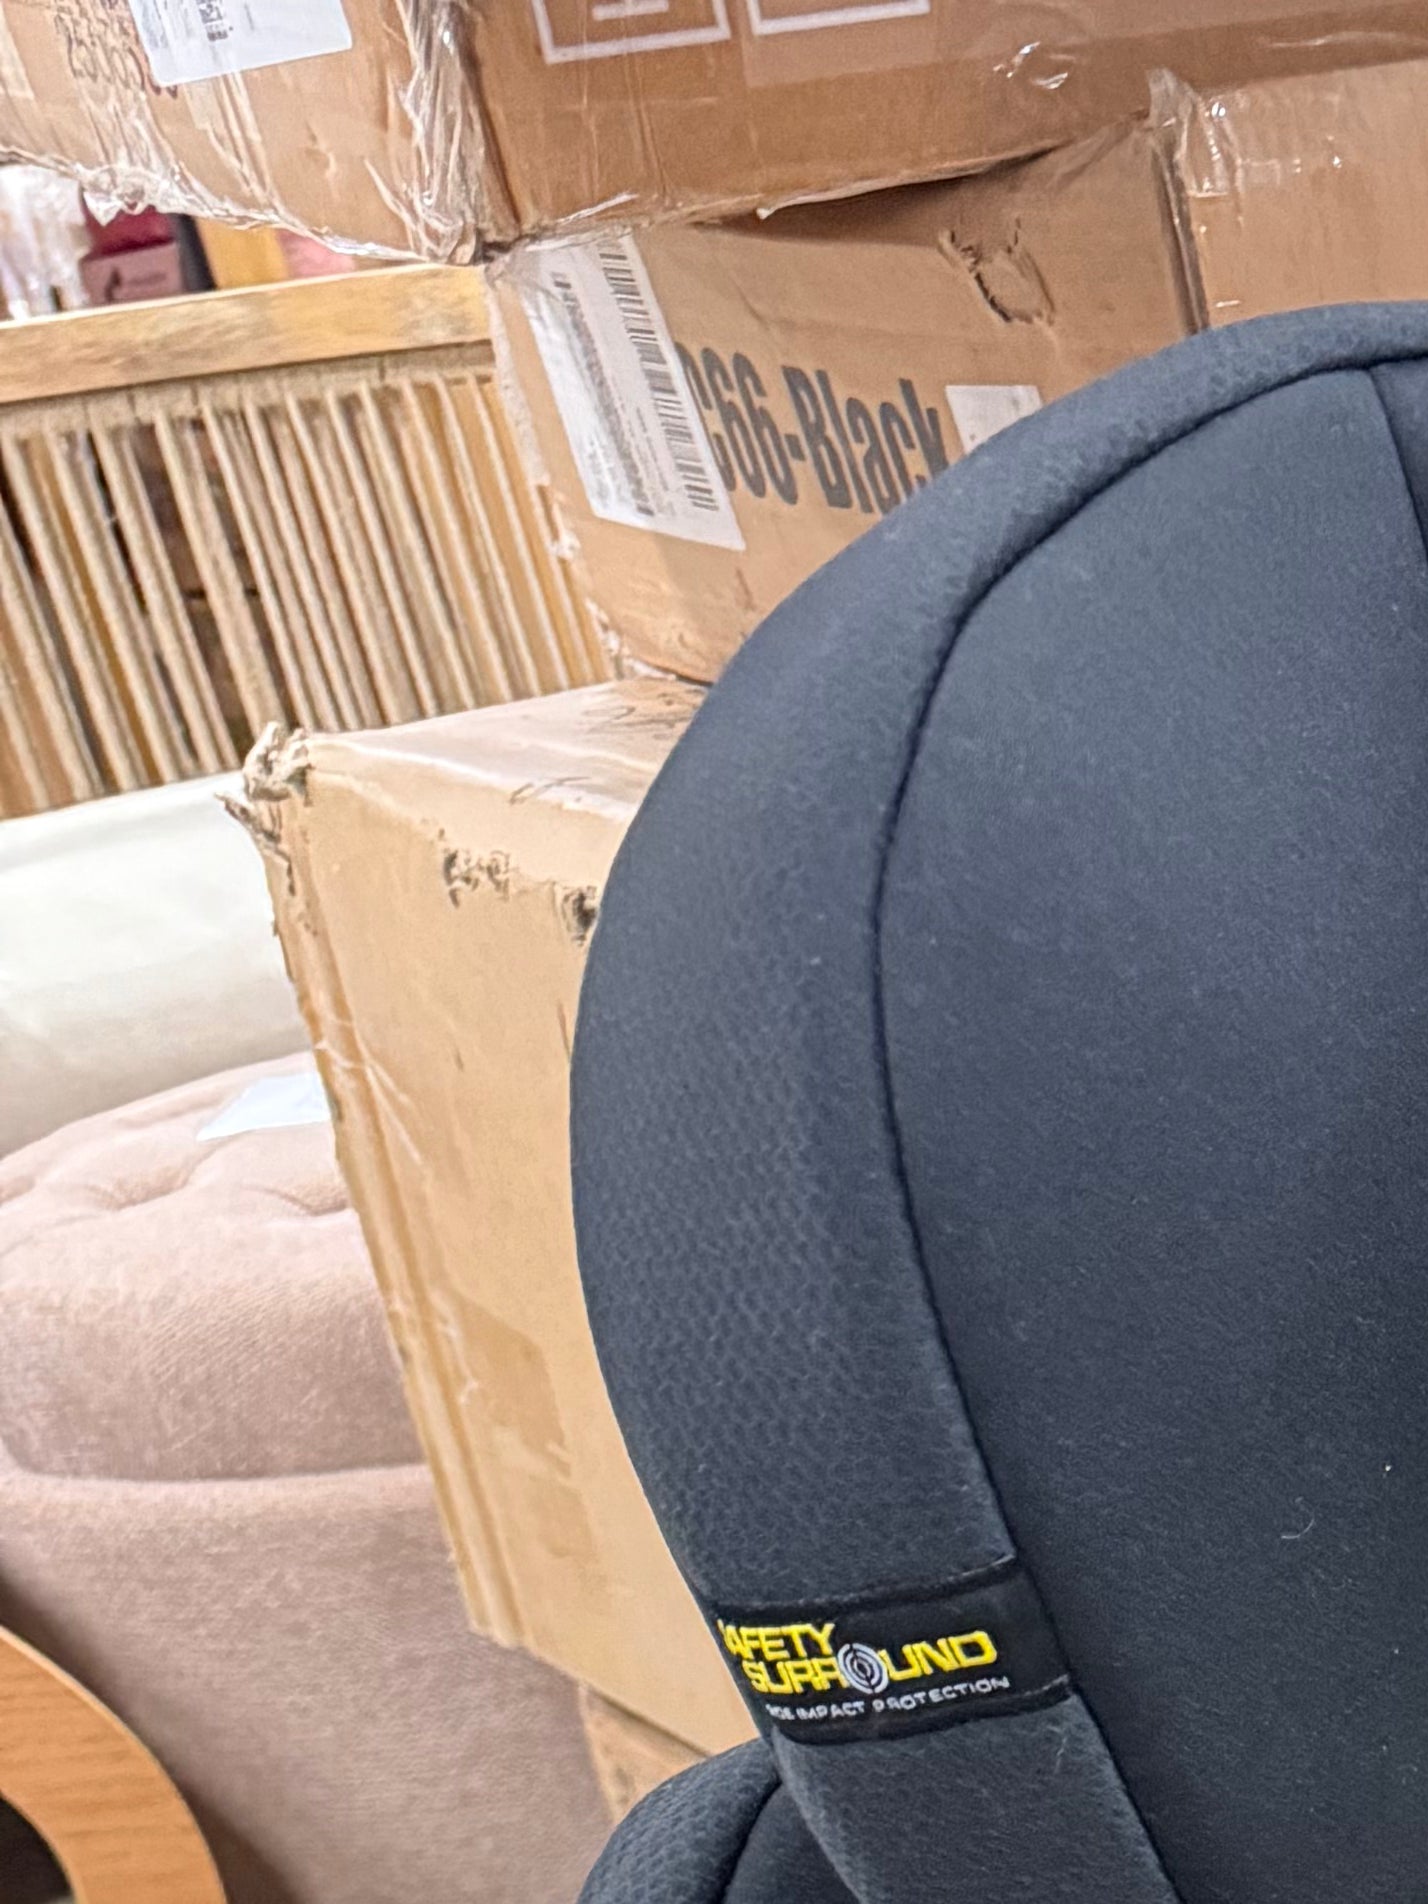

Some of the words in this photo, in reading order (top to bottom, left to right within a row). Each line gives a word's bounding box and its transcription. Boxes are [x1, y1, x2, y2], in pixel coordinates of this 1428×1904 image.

[717, 1618, 836, 1661] AFETY
[742, 1630, 998, 1695] SURROUND
[795, 1700, 865, 1721] IMPACT
[872, 1675, 1011, 1713] PROTECTION
